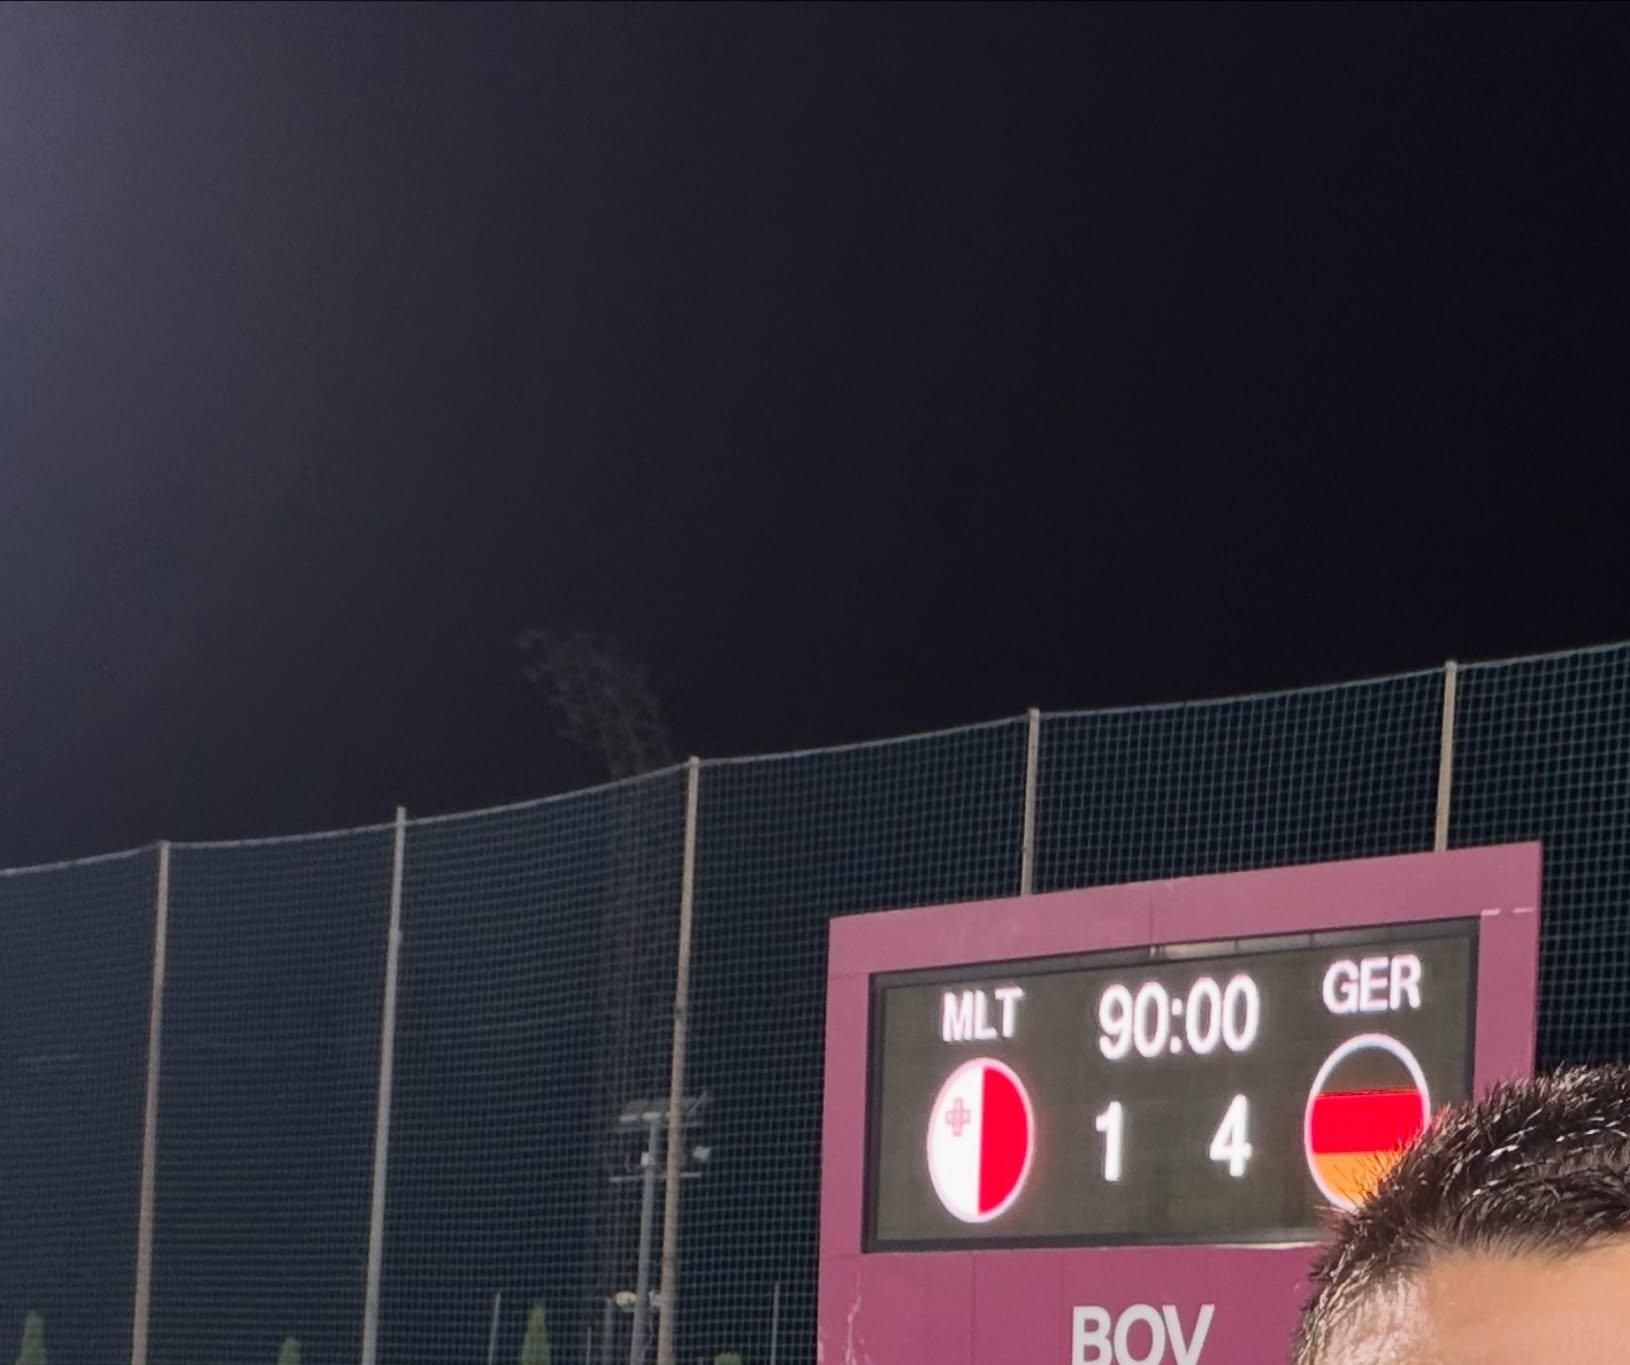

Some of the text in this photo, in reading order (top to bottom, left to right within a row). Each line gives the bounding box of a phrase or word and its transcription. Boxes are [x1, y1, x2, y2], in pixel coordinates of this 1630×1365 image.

[942, 954, 1422, 1061] MLT 90:00 GER
[1095, 1094, 1253, 1181] 1 4
